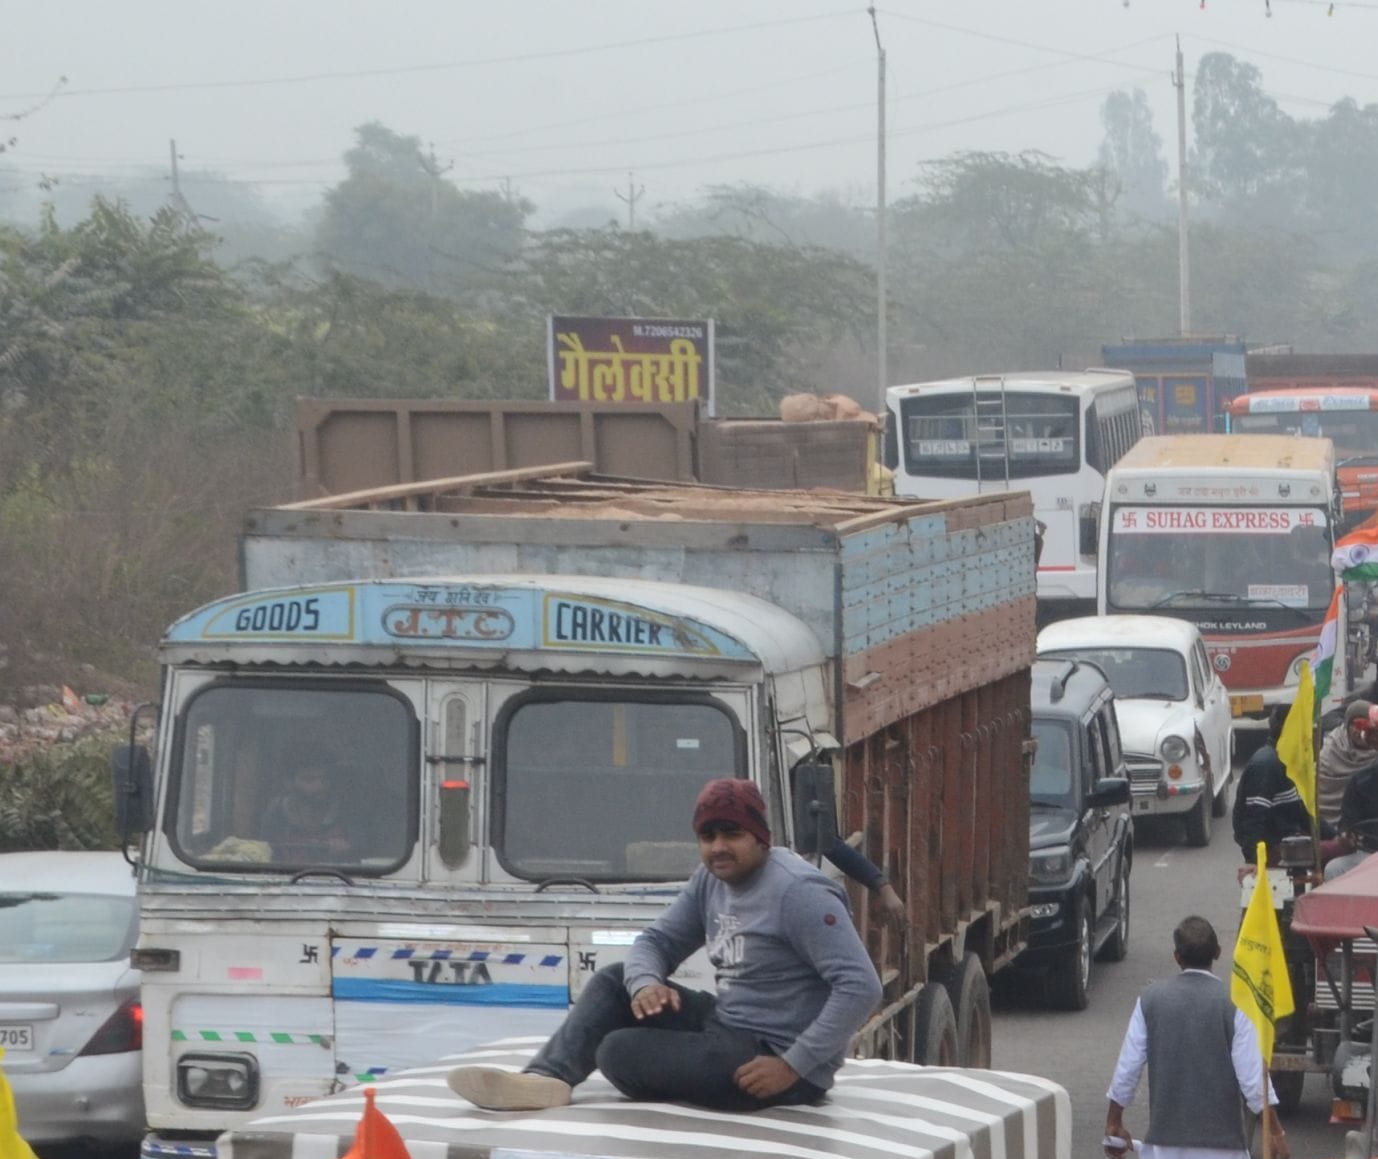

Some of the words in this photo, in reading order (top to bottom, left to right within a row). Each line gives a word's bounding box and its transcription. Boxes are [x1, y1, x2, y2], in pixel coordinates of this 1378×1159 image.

[556, 332, 702, 402] गैलेक्सी
[1146, 511, 1208, 529] SUHAG
[1211, 511, 1291, 529] EXPRESS
[235, 598, 320, 632] GOODS
[555, 602, 665, 646] CARRIER
[1219, 622, 1268, 630] LEYLAND
[408, 960, 494, 985] TATA
